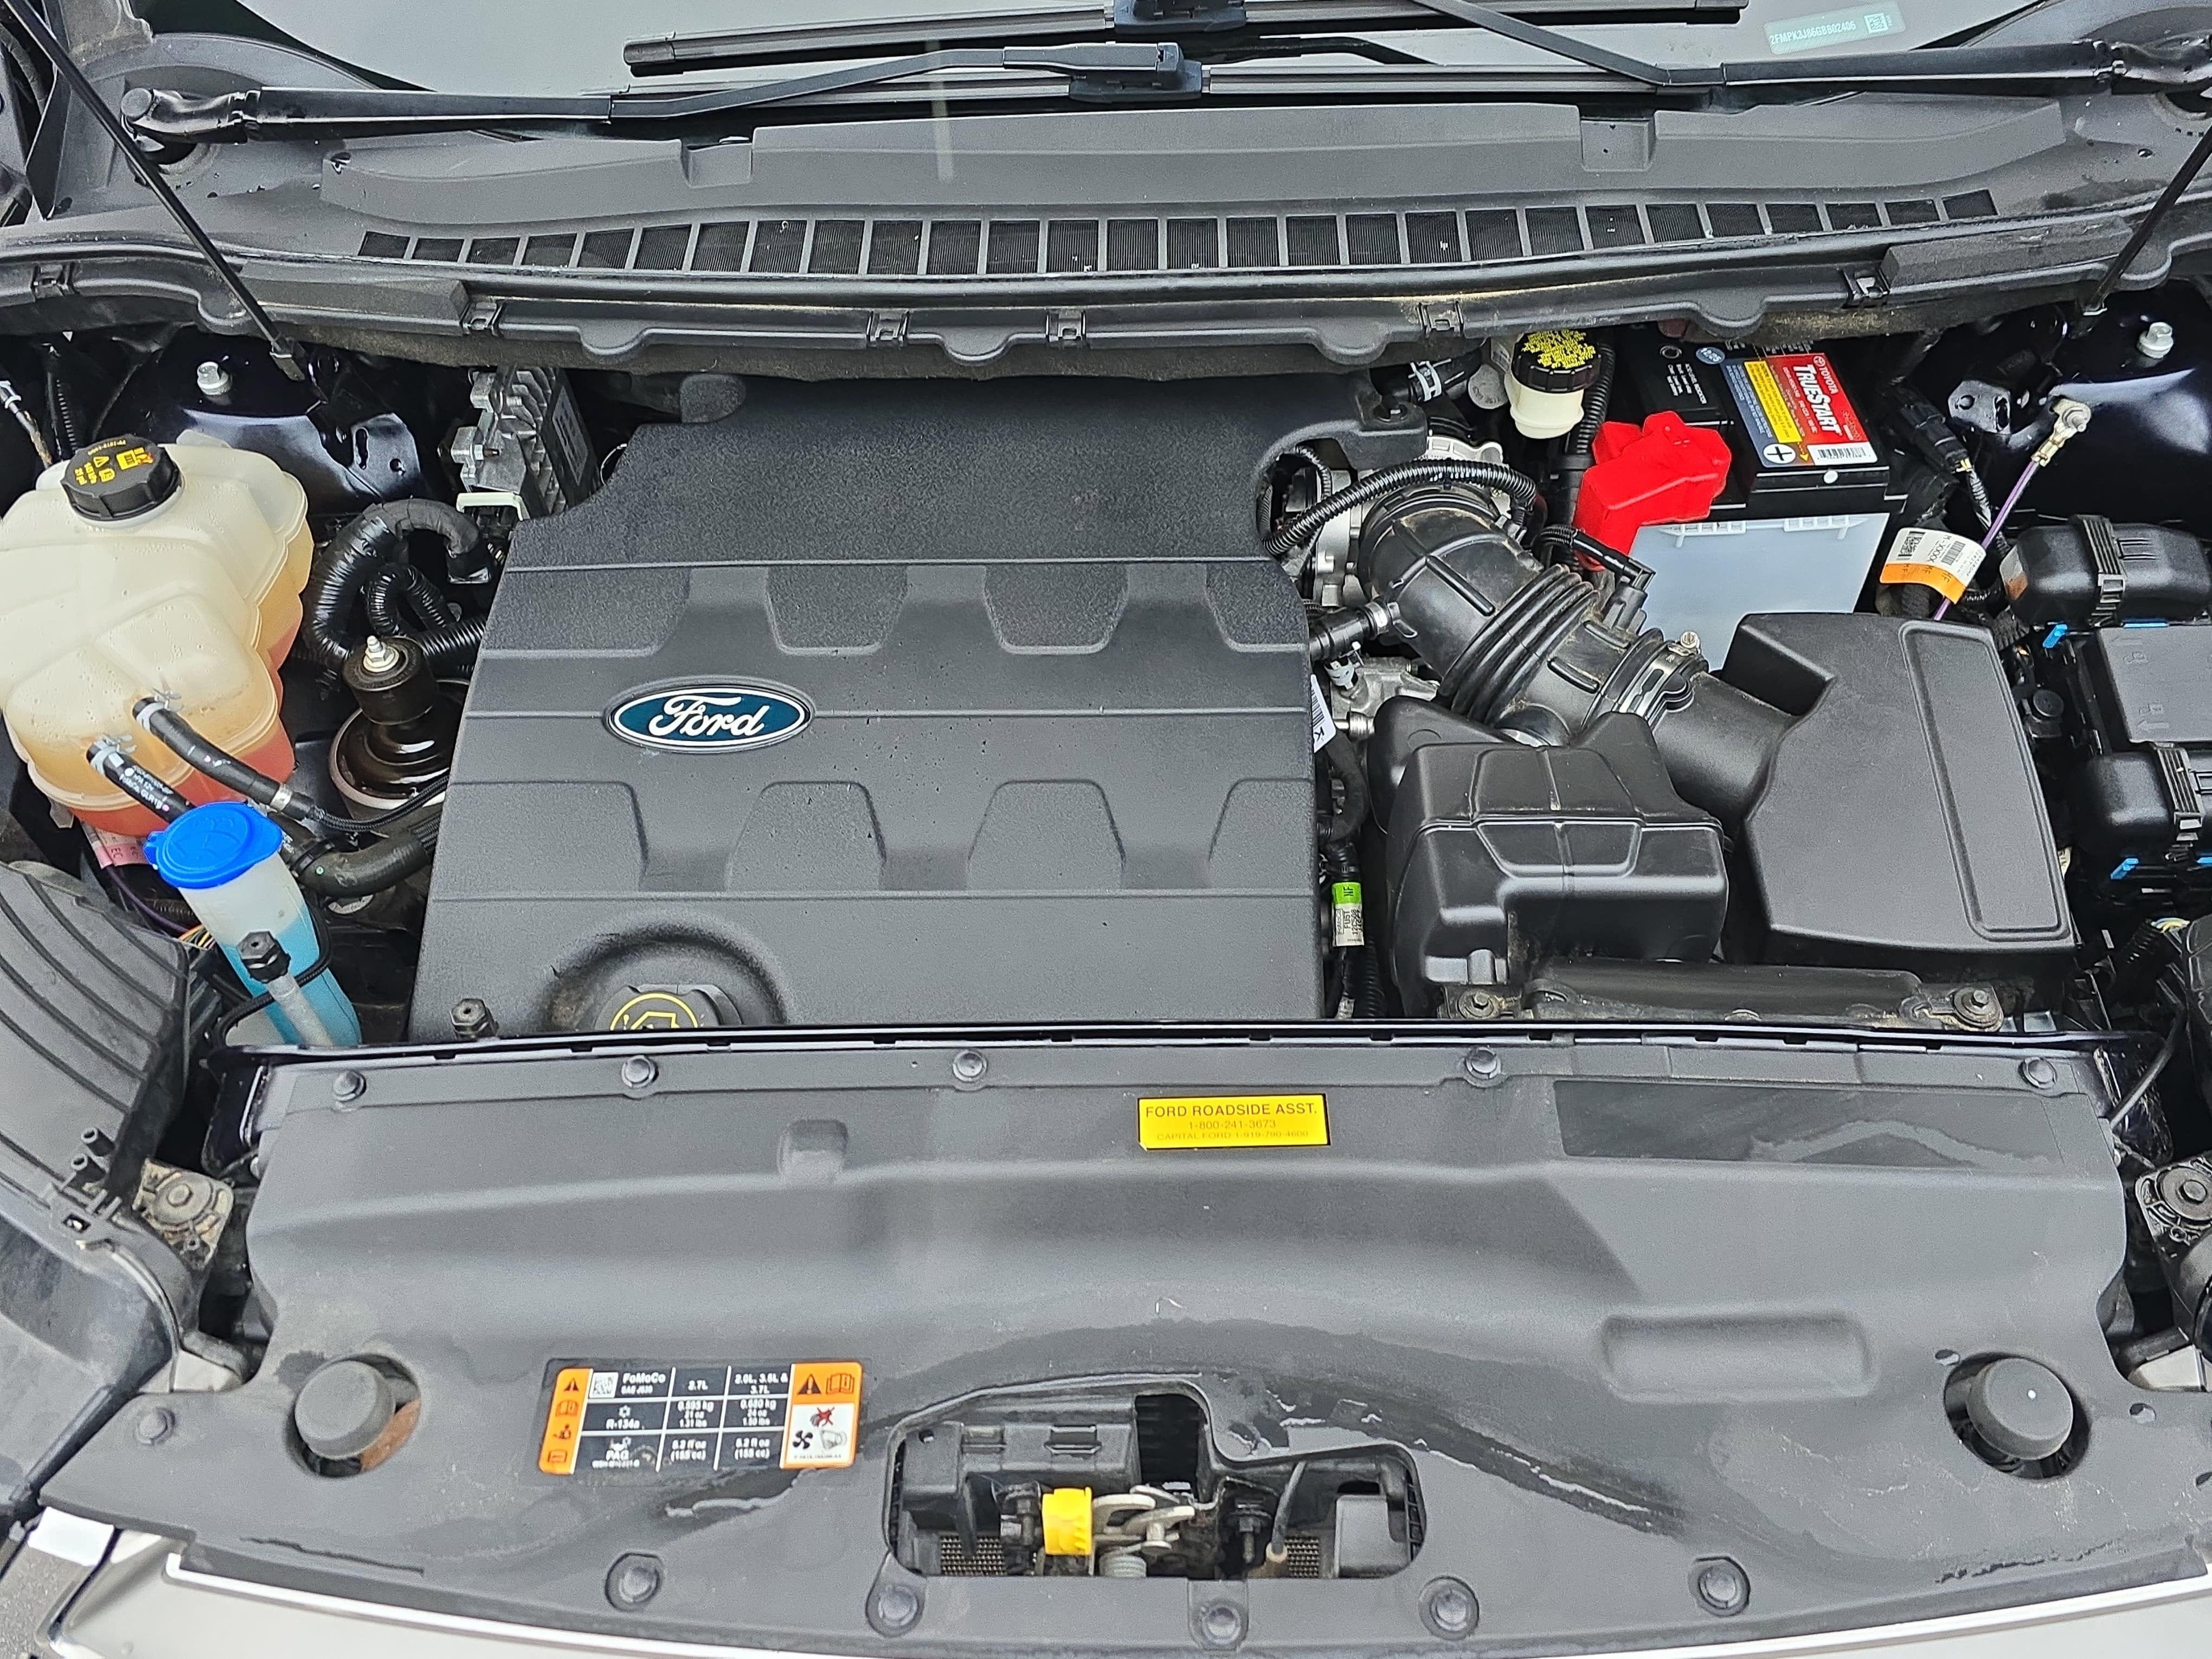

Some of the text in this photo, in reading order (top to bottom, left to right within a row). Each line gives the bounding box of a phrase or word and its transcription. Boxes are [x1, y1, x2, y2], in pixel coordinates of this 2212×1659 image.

[1822, 364, 1838, 394] TOYOTA
[649, 695, 770, 736] Ford
[1146, 1103, 1317, 1118] FORD ROADSIDE ASST.
[1189, 1120, 1276, 1130] 1-800-241-3673
[1202, 1131, 1231, 1140] FORD
[622, 1372, 666, 1384] FoMoCo
[606, 1418, 640, 1430] R-134a
